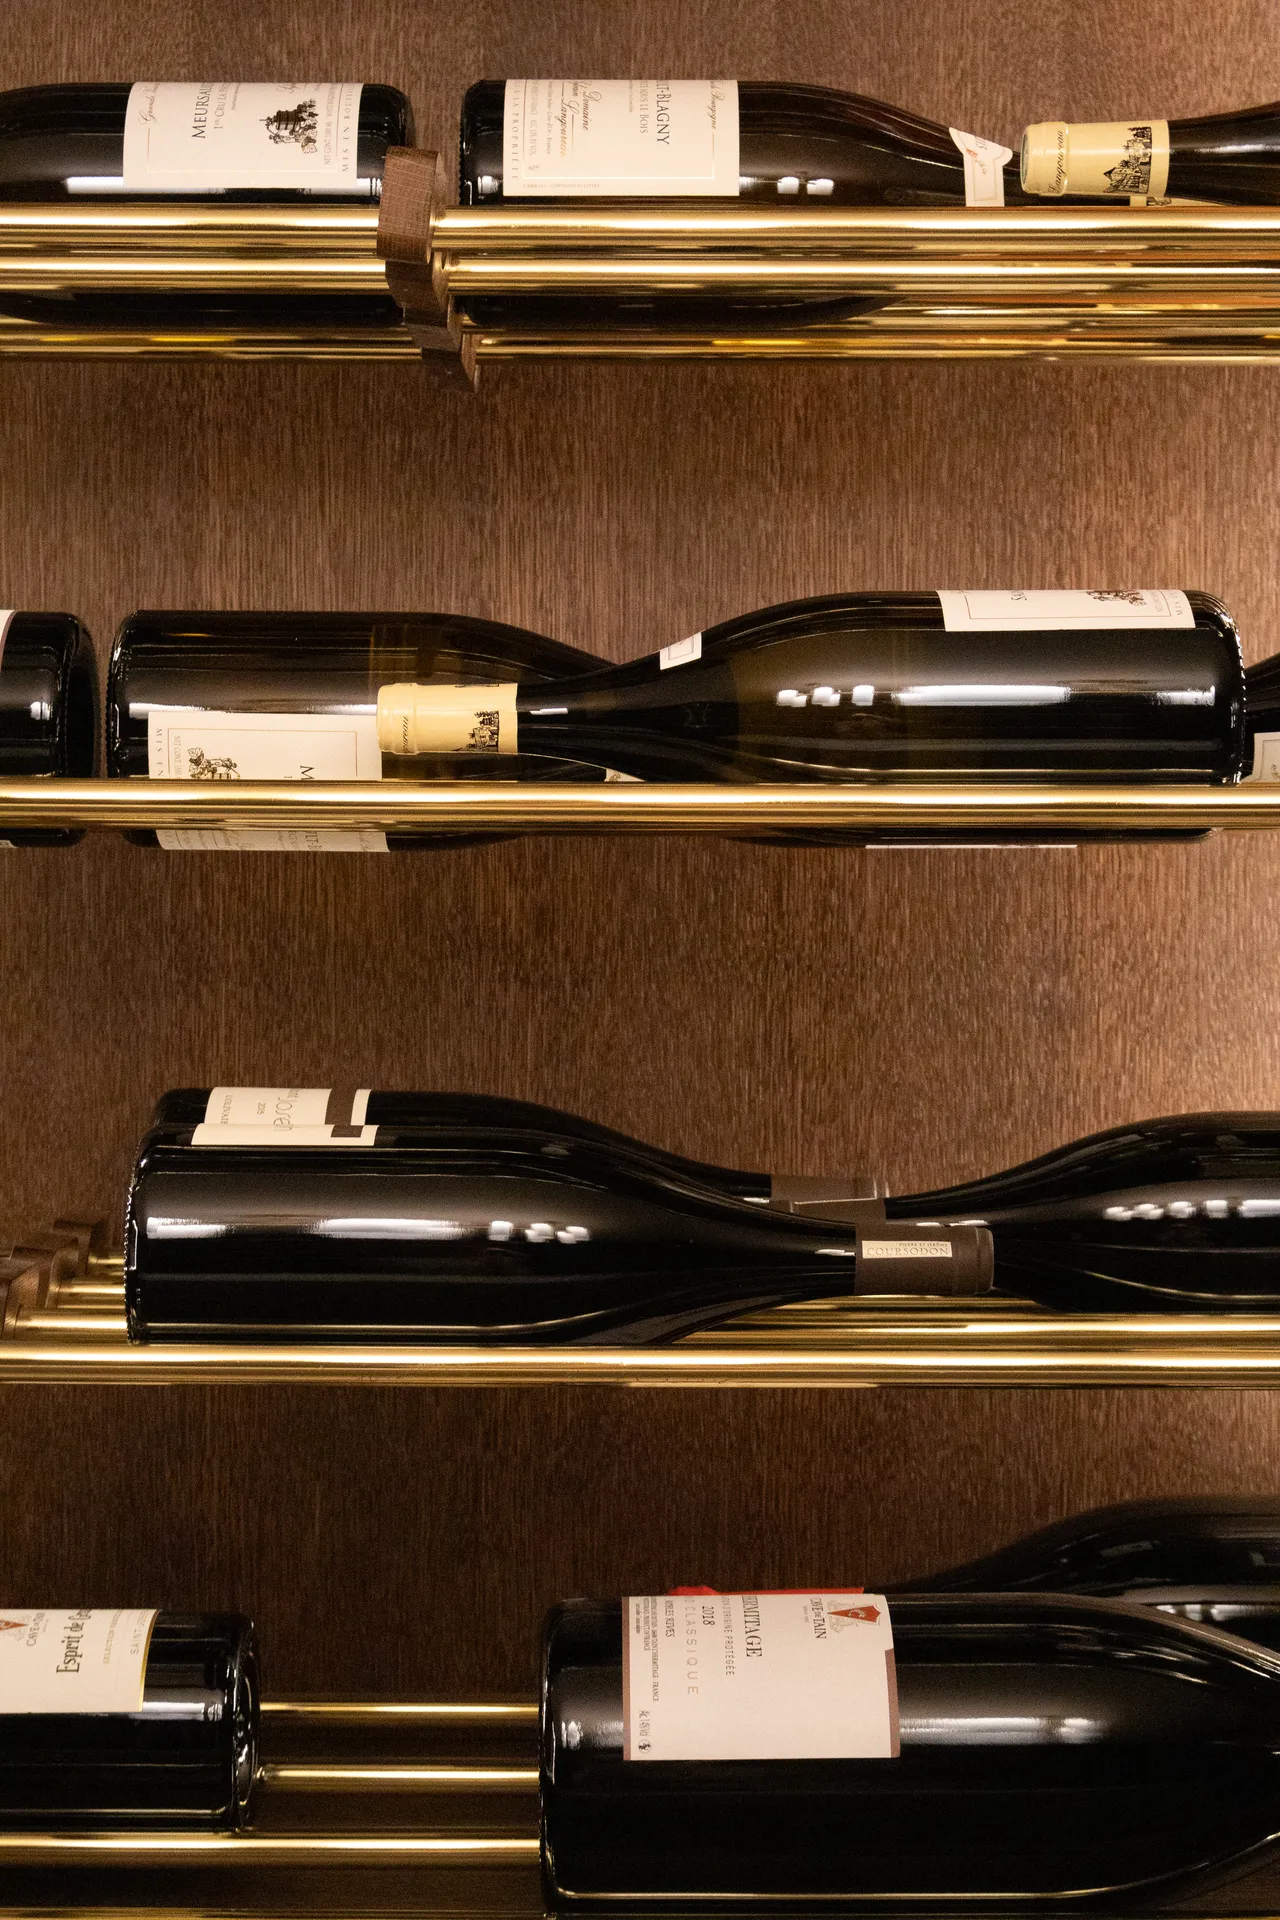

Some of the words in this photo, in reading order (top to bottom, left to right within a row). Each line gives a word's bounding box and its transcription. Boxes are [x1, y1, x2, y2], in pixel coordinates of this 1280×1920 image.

[582, 90, 603, 132] Domaine
[343, 126, 351, 140] EN
[640, 114, 649, 134] BOIS
[342, 149, 350, 173] MIS
[867, 1247, 949, 1256] COURSODON
[64, 1621, 85, 1633] de
[702, 1605, 716, 1627] 2018
[742, 1595, 763, 1658] ERMITAGE
[665, 1617, 676, 1638] RIVES
[813, 1617, 827, 1639] TAIN
[56, 1634, 83, 1673] Esprit
[685, 1606, 699, 1695] CLASSIQUE
